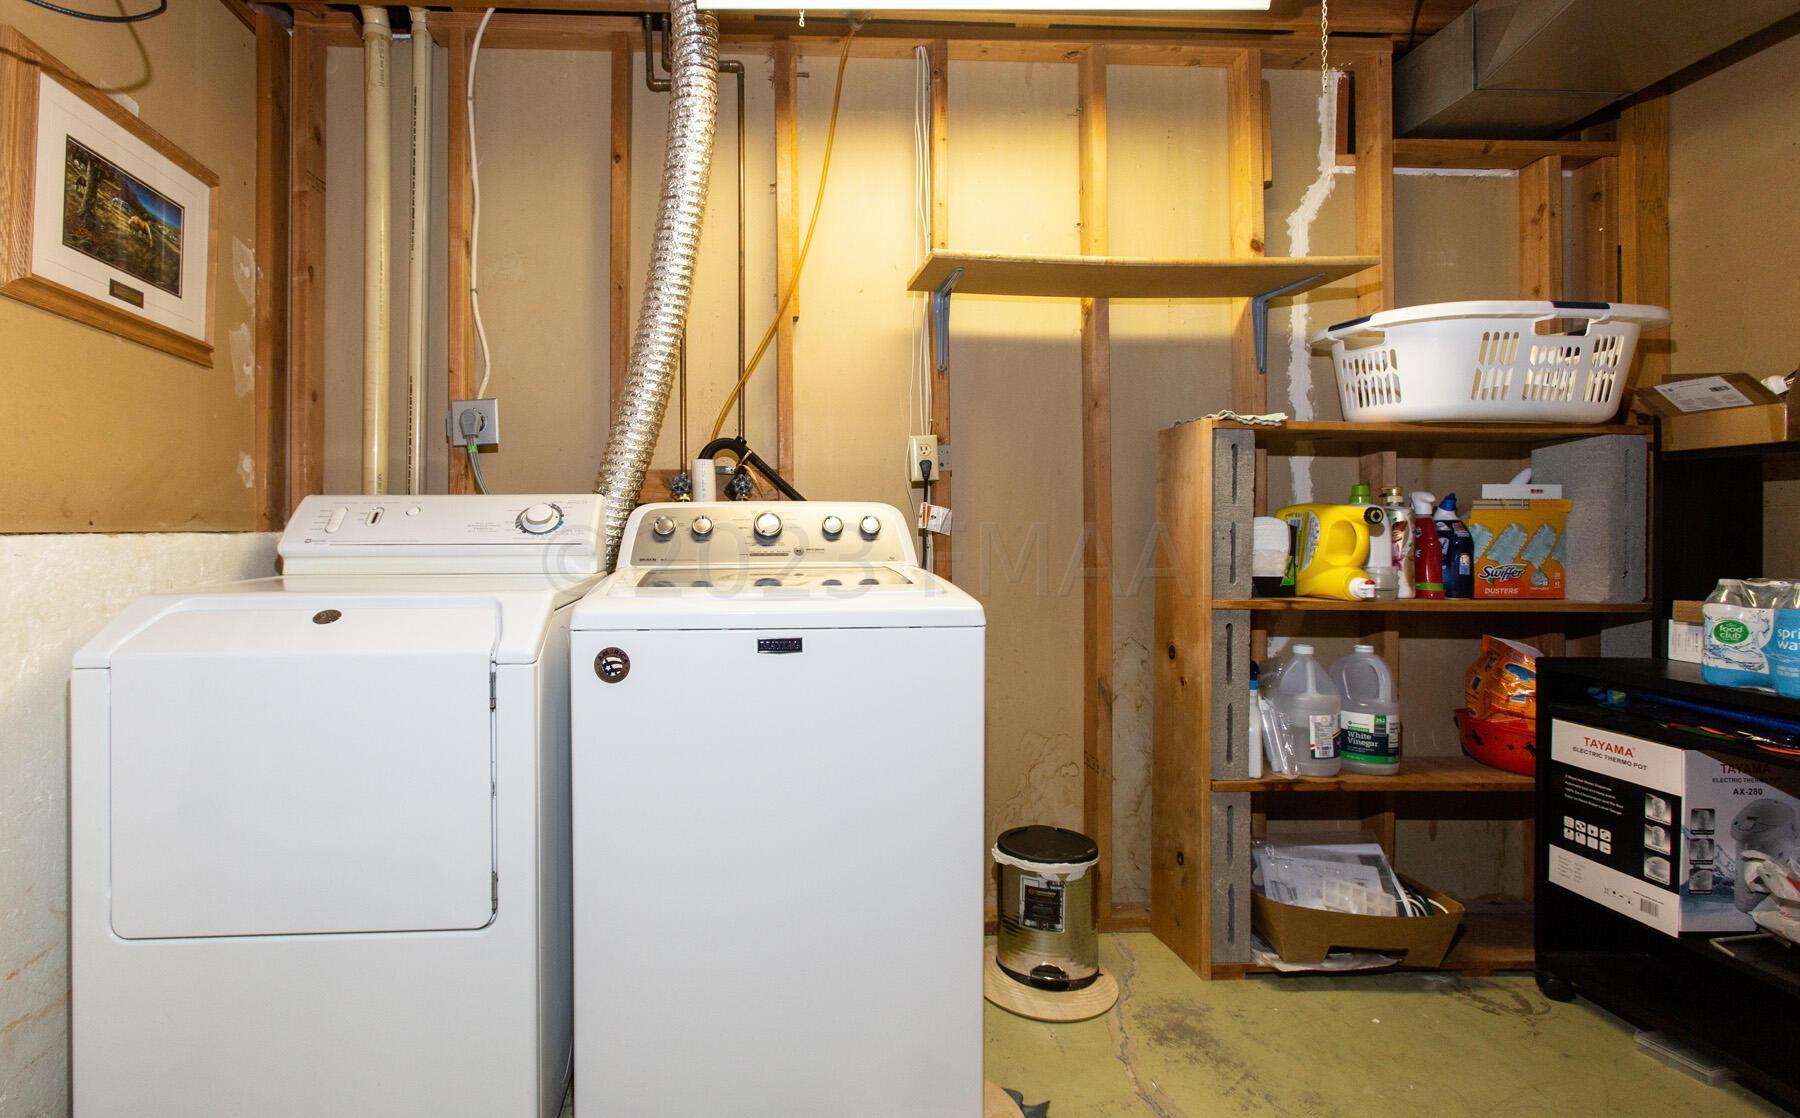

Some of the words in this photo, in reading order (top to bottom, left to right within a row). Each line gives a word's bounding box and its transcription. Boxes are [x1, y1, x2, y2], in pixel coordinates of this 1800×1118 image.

[1479, 564, 1526, 582] Swiffer
[1484, 587, 1519, 595] DUSTERS
[1719, 624, 1743, 633] food
[1777, 640, 1800, 651] wa
[1347, 730, 1372, 740] White
[1347, 737, 1379, 748] Vinegar
[1583, 736, 1634, 758] TAYAMA
[1572, 746, 1603, 759] ELECTRIC
[1604, 754, 1633, 767] THERMO
[1633, 762, 1648, 771] POT
[1733, 788, 1763, 796] AX-280
